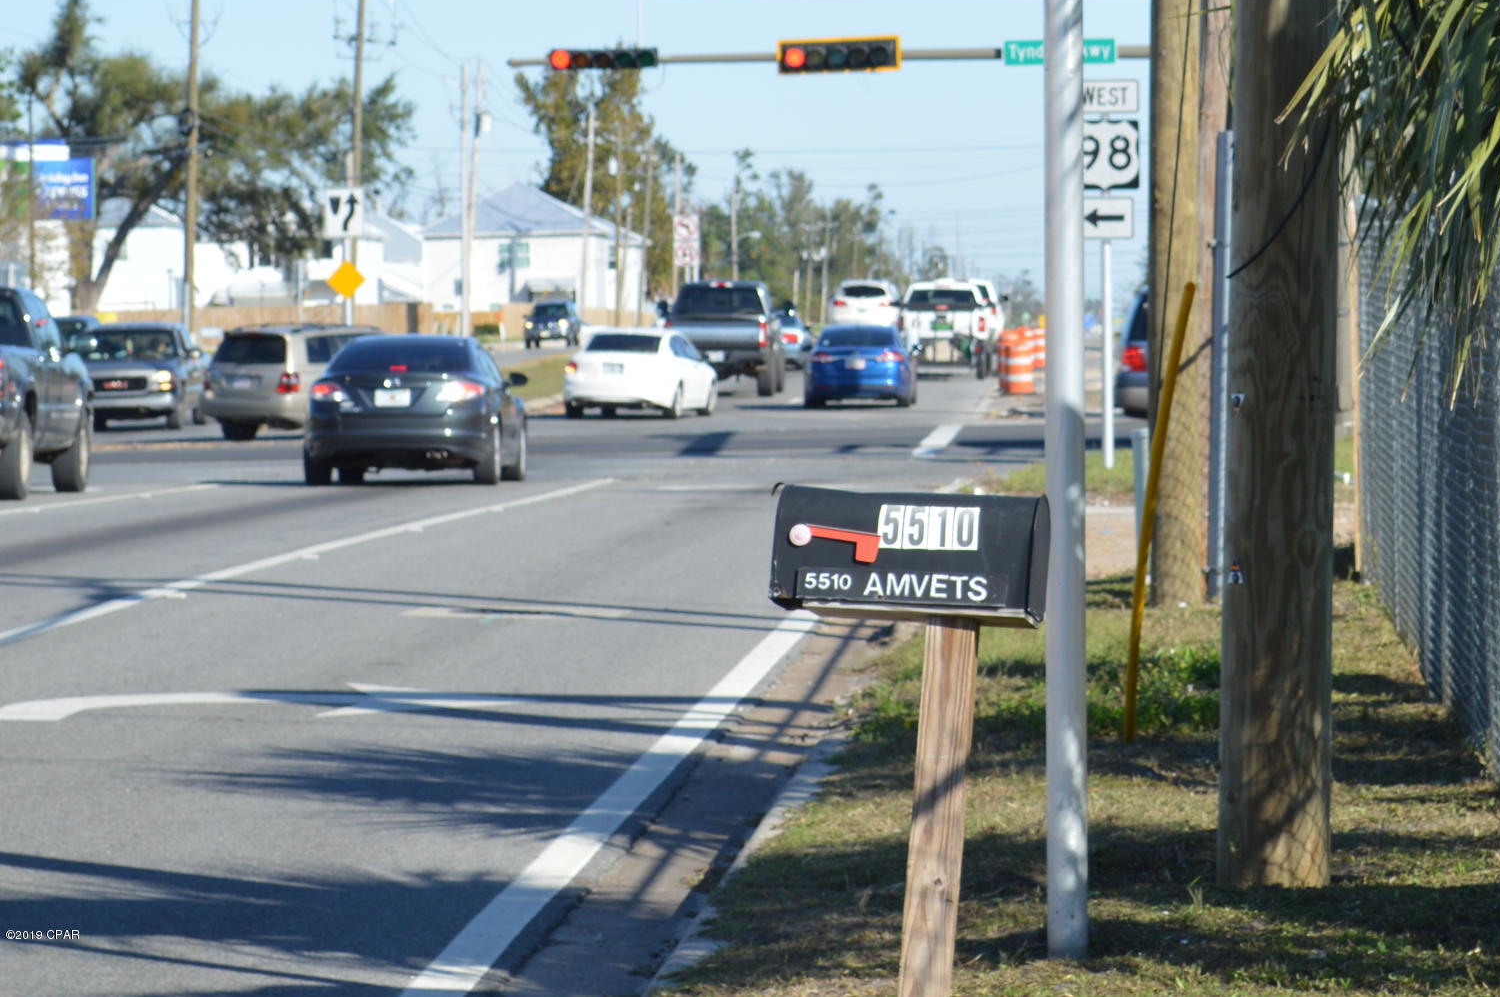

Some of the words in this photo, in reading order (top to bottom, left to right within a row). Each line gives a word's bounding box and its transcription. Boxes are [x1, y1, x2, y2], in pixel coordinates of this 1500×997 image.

[1083, 87, 1128, 106] WEST
[1083, 135, 1132, 170] 98
[881, 507, 976, 548] 5510
[804, 572, 852, 591] 5510
[863, 572, 989, 602] AMVETS
